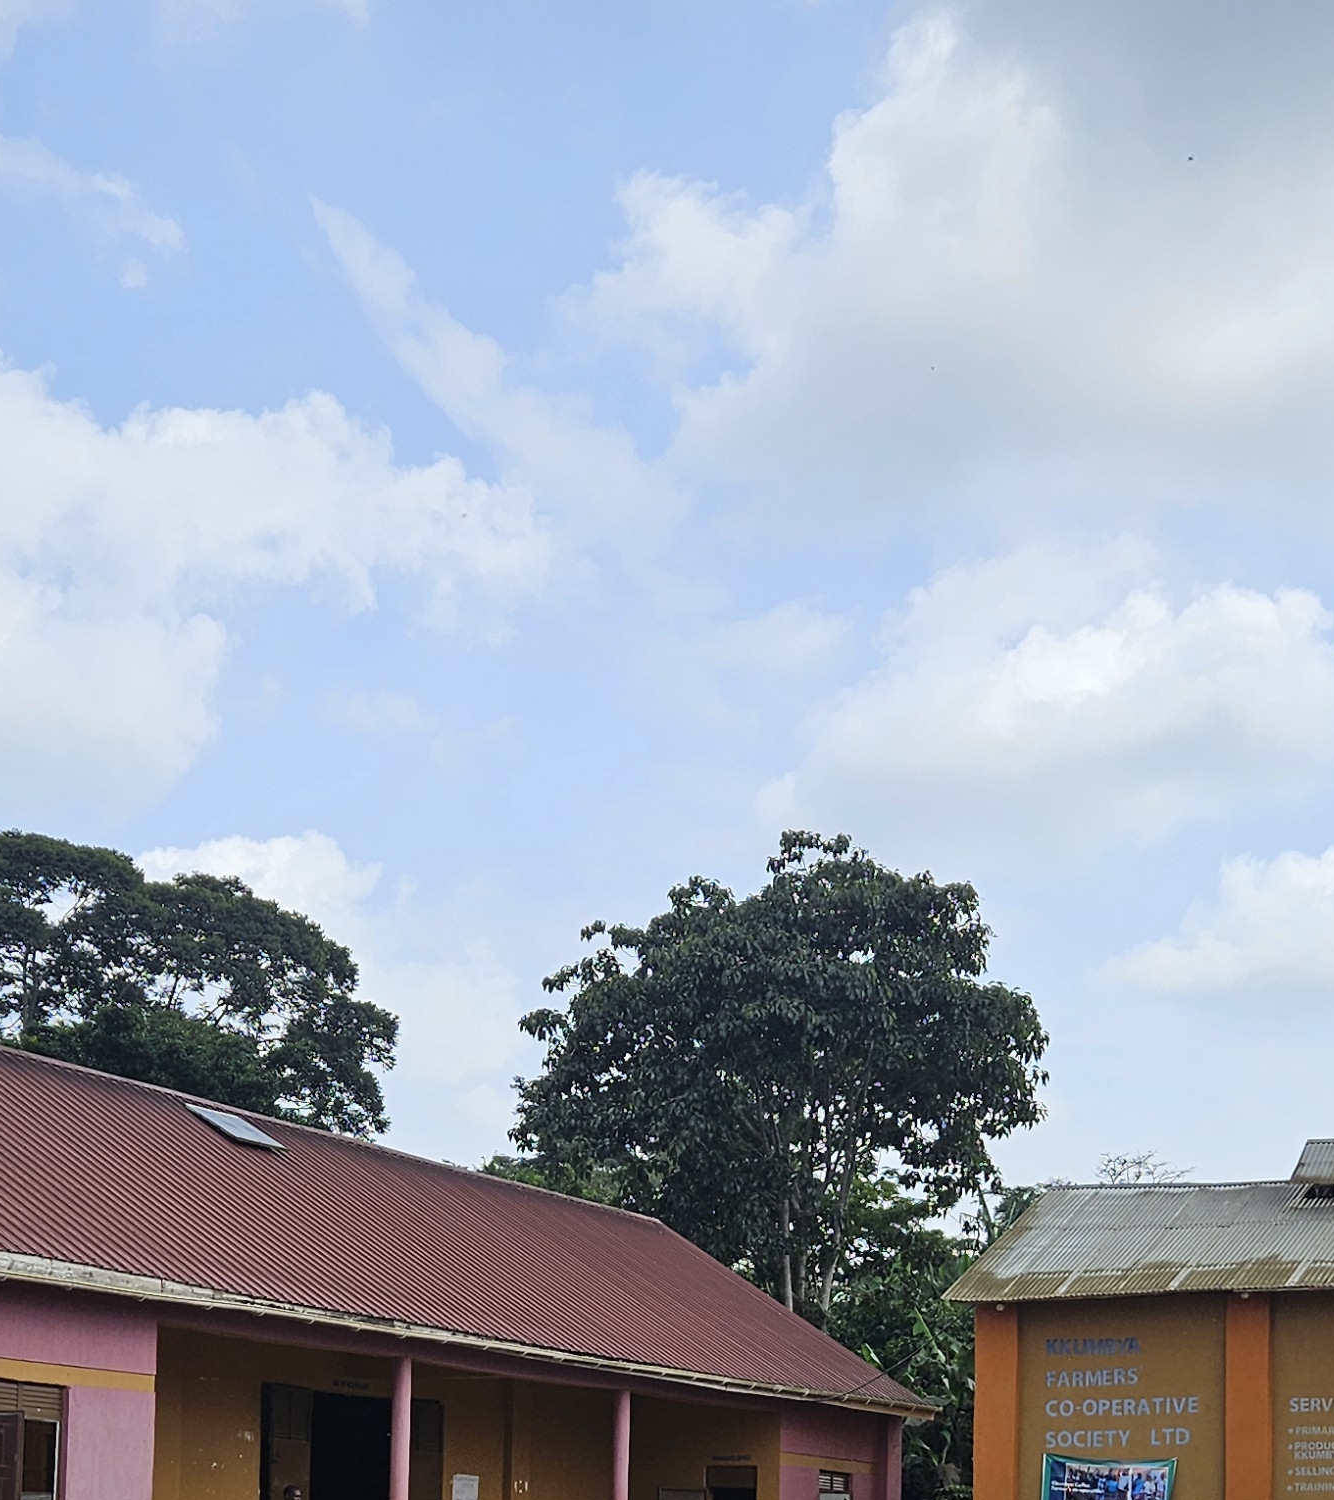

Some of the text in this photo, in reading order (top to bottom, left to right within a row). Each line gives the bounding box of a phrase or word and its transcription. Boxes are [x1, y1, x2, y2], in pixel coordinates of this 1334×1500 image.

[1045, 1336, 1142, 1356] KKUMBYA
[1045, 1396, 1200, 1417] CO-OPERATIVE
[1045, 1427, 1191, 1448] SOCIETY LTD
